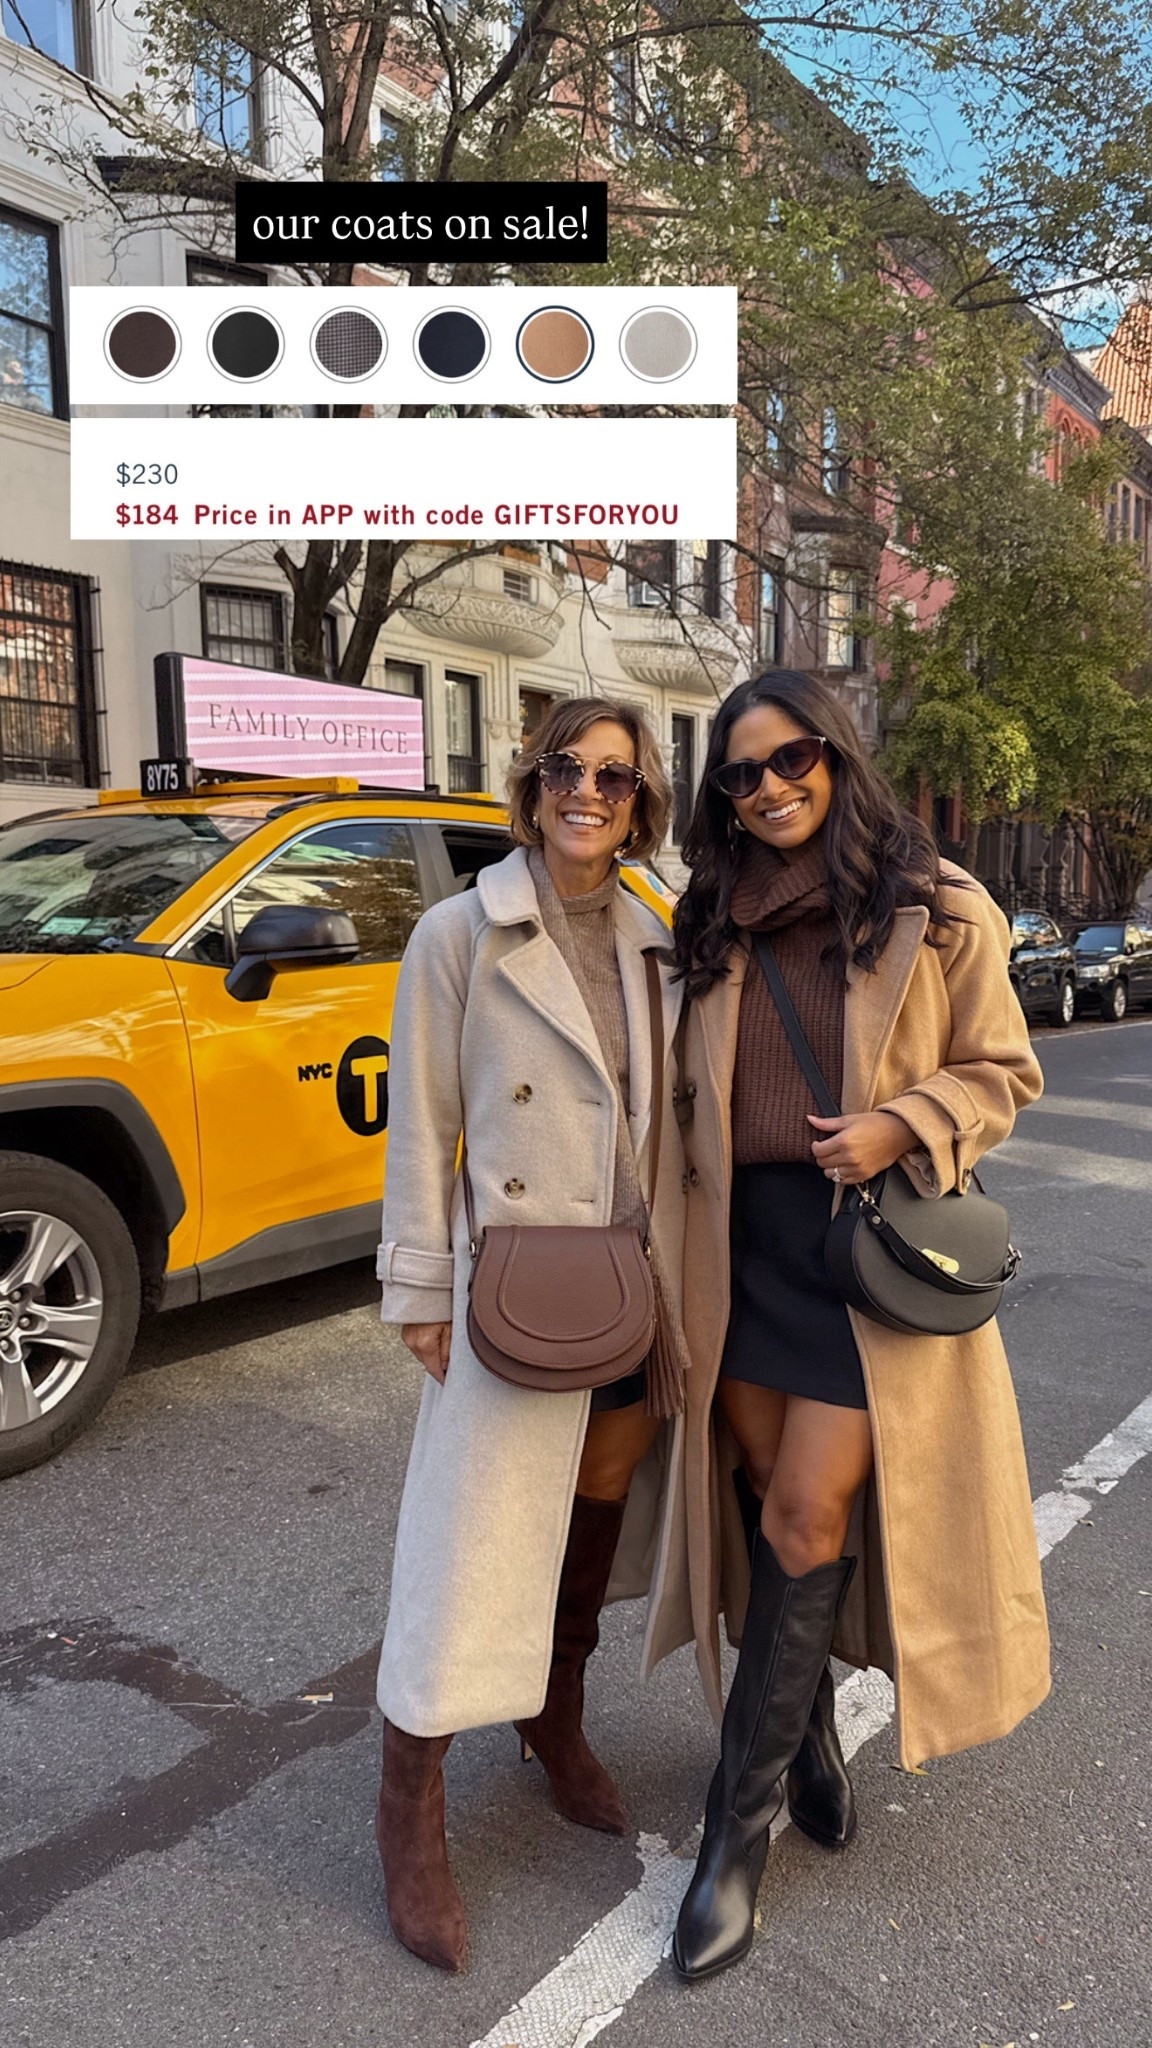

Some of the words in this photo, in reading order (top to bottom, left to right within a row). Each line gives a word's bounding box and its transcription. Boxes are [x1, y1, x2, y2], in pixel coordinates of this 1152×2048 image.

[209, 703, 310, 741] FAMILY
[322, 720, 408, 755] OFFICE
[147, 763, 179, 791] 8Y75
[297, 1063, 332, 1082] NYC
[350, 1054, 388, 1123] T
